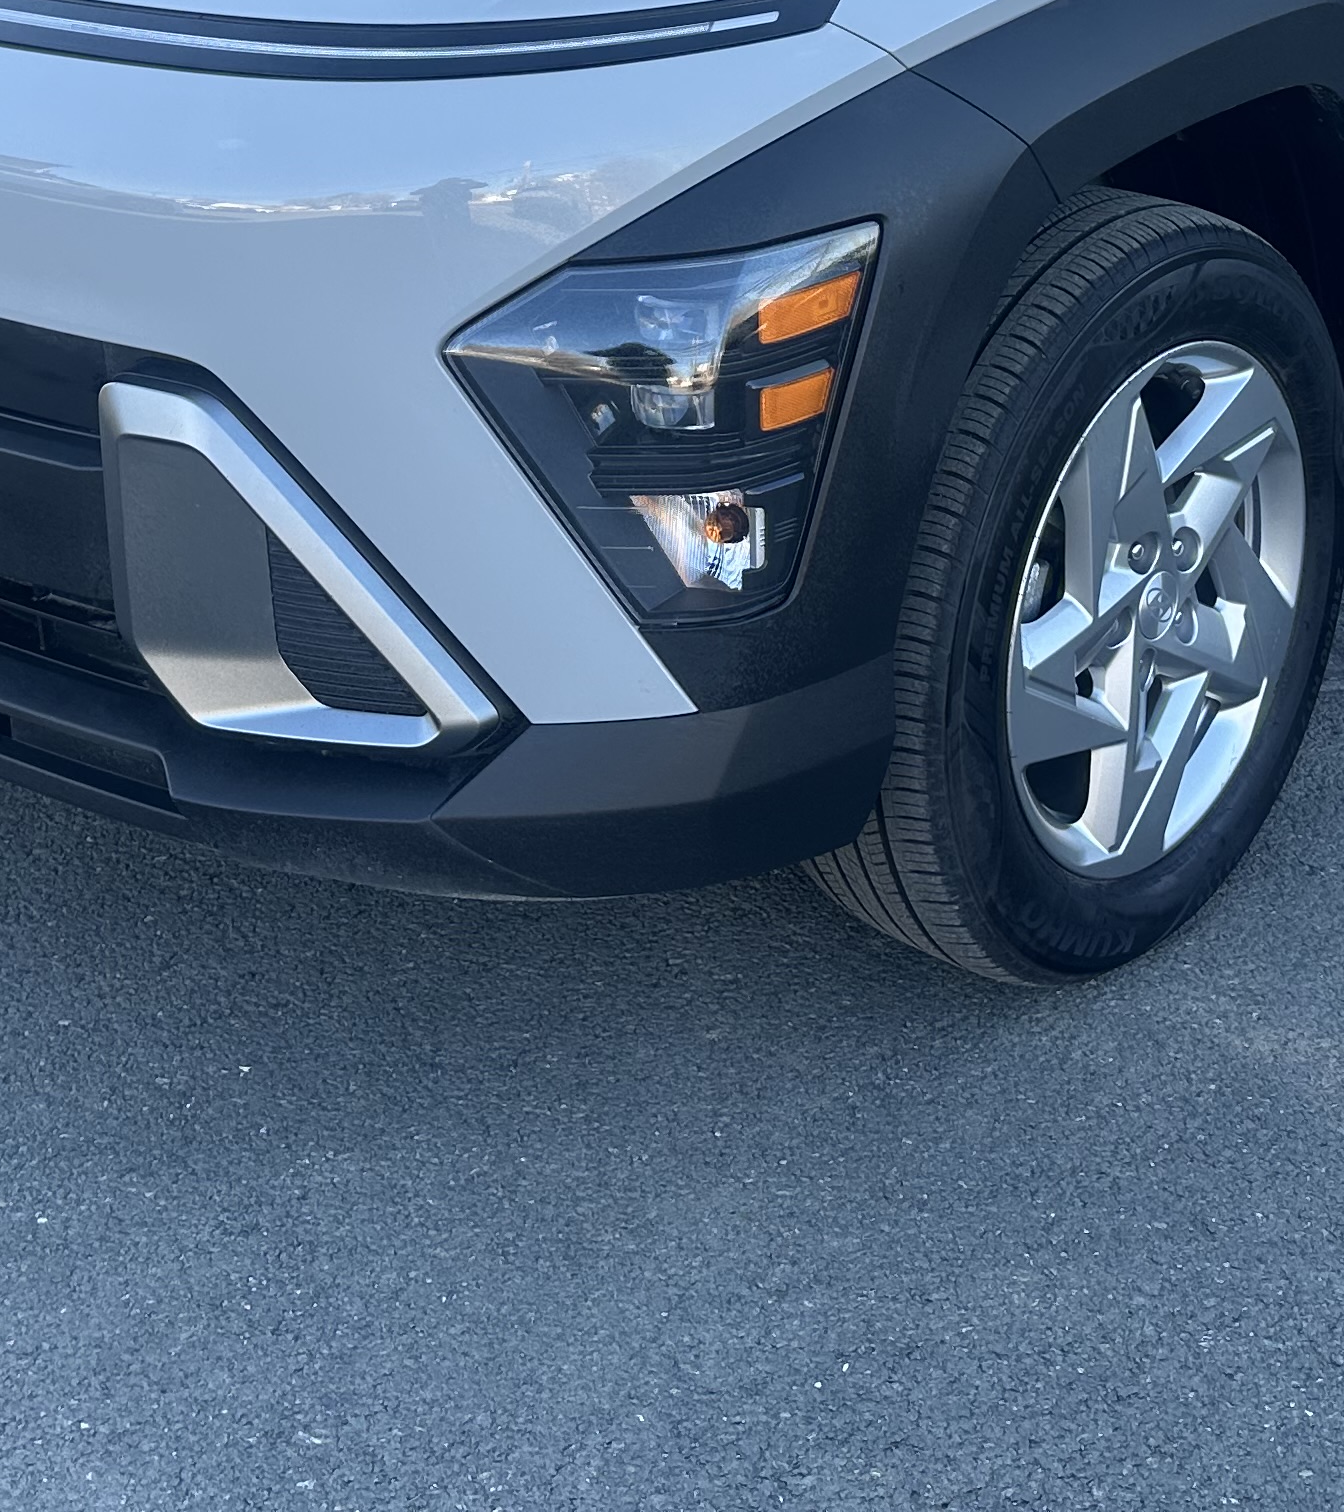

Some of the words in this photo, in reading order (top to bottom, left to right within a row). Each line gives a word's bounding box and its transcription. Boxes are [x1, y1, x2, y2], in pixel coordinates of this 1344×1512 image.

[978, 545, 1015, 683] PREMIUM
[1010, 381, 1086, 542] ALL-SEASON
[1022, 900, 1138, 959] KUMHO
